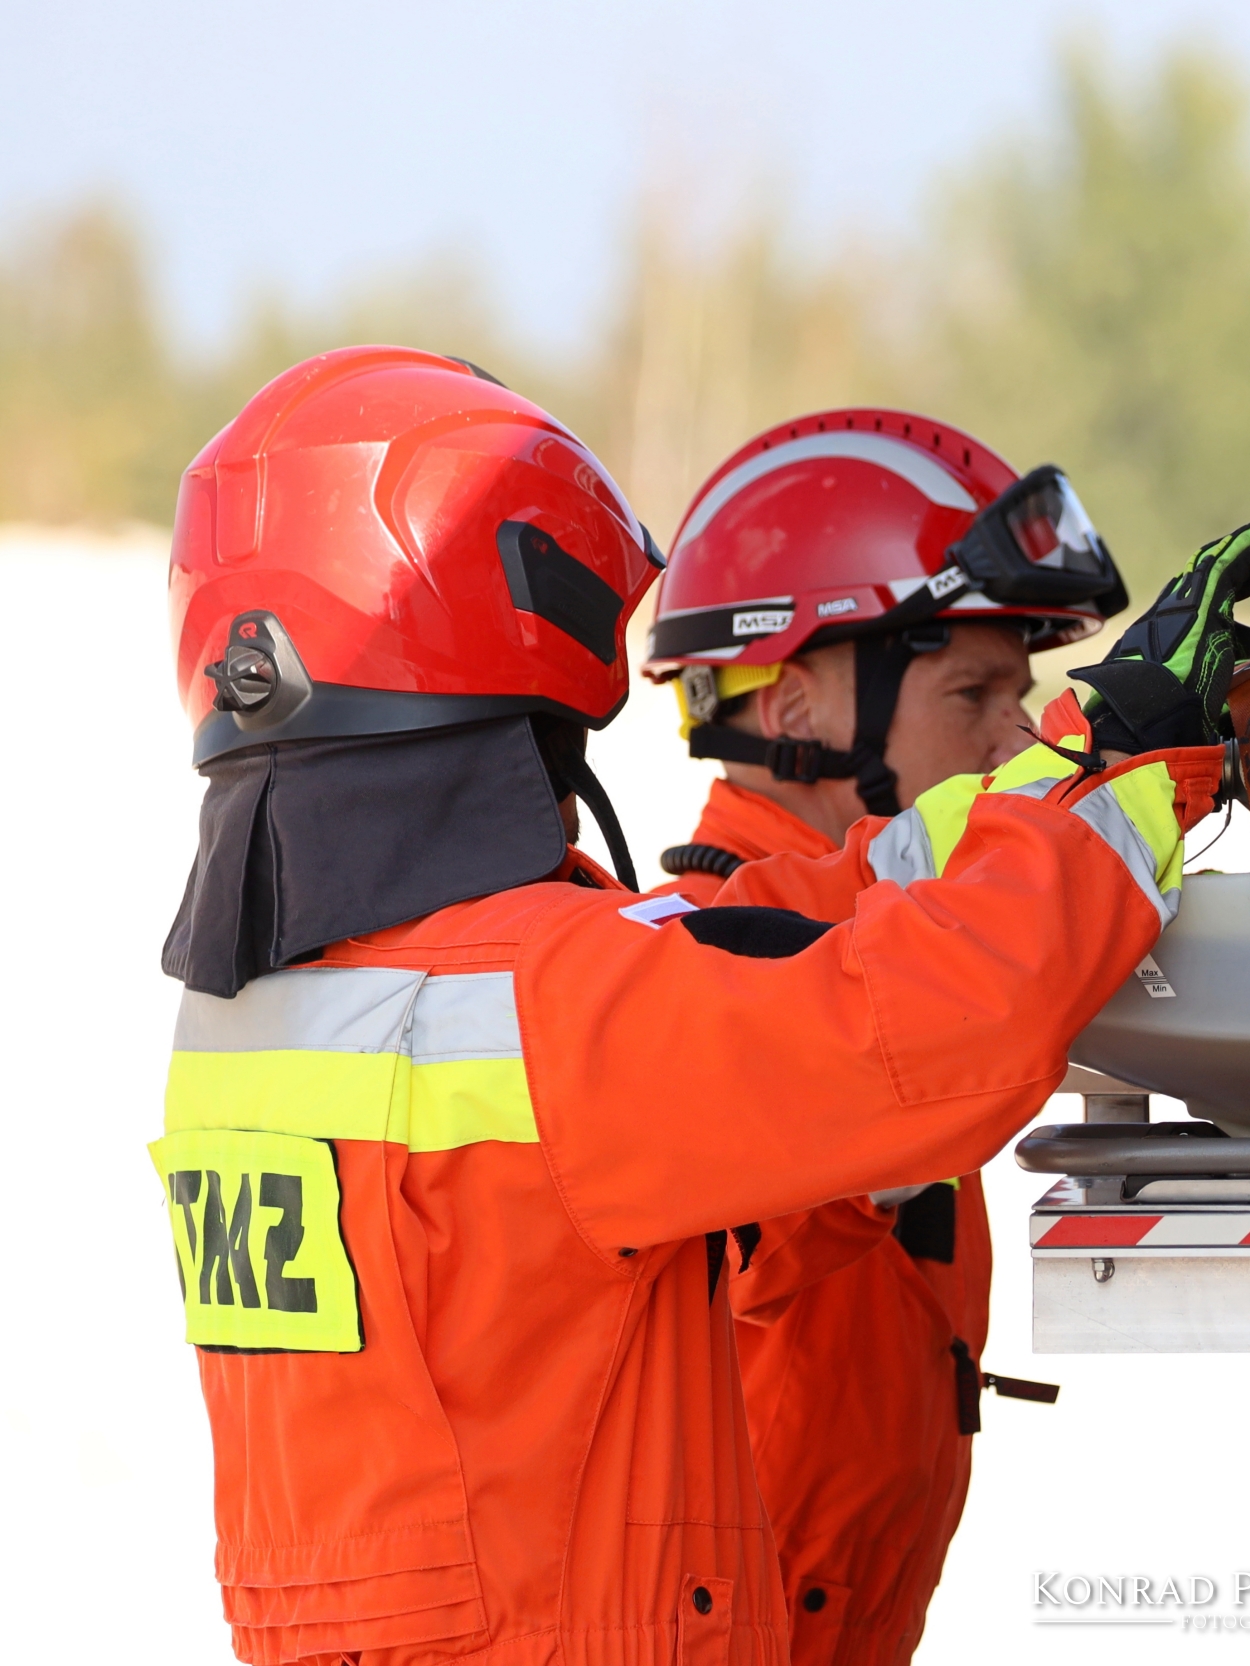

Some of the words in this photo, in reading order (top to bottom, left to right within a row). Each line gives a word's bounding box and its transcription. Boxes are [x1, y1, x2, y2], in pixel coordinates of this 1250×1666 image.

[817, 597, 858, 618] MSA
[1141, 969, 1159, 977] Max
[1152, 985, 1167, 993] Min
